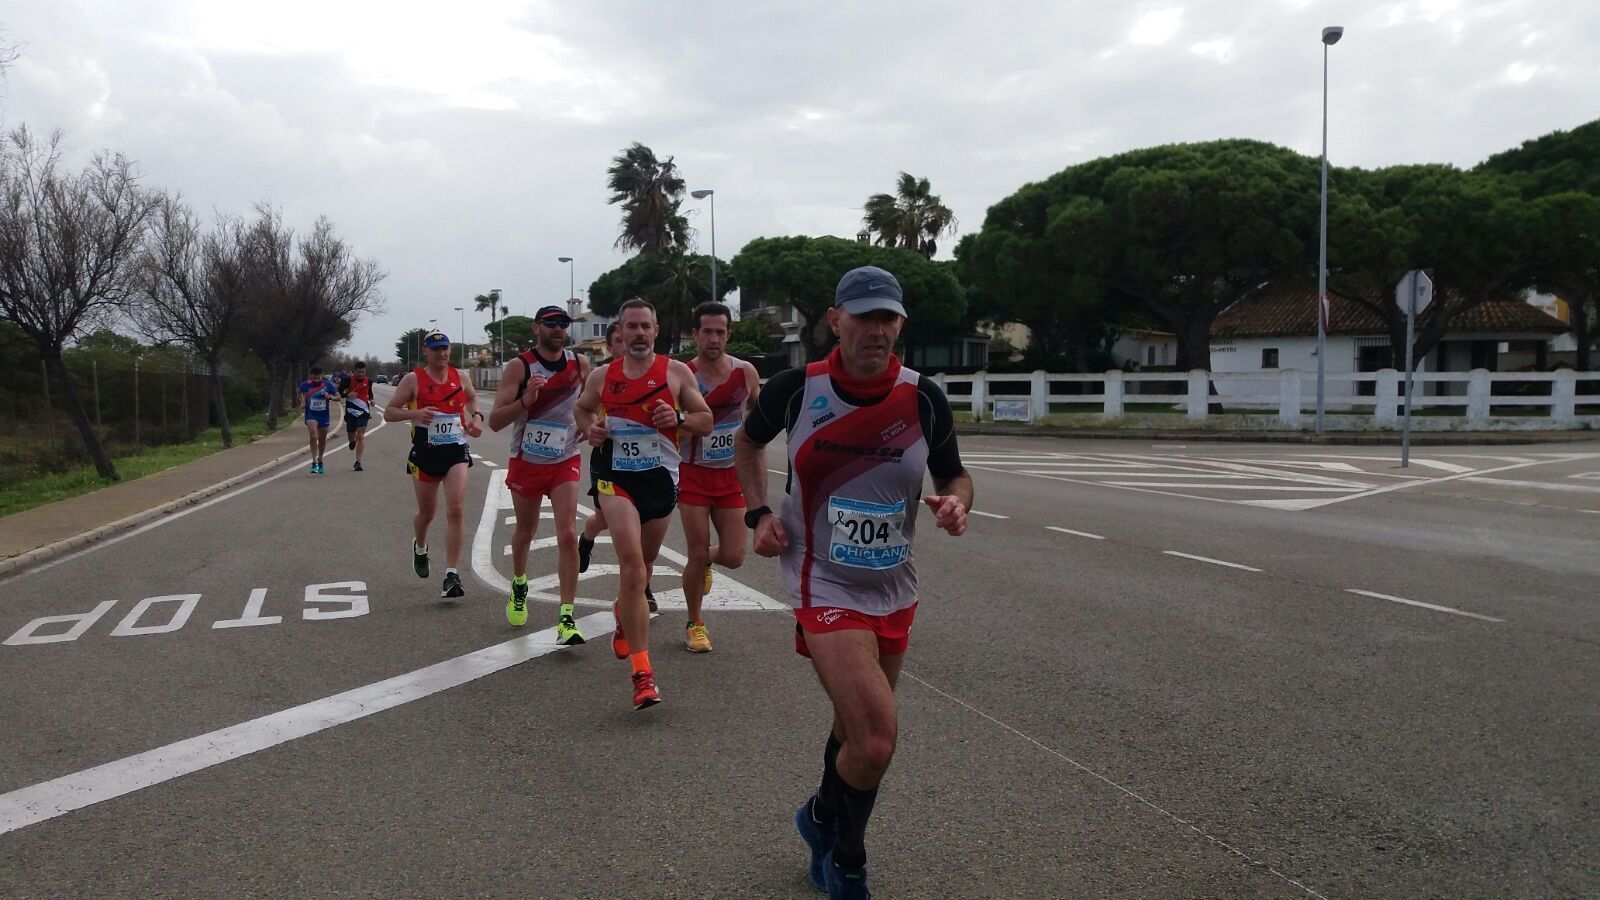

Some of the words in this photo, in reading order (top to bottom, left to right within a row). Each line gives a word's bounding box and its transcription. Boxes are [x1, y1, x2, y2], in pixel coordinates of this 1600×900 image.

[434, 422, 453, 434] 107
[534, 430, 551, 445] 37
[711, 433, 733, 449] 206
[621, 442, 640, 457] 85
[814, 440, 905, 458] Vanessa
[614, 457, 661, 469] CHICLANA
[844, 519, 890, 545] 204
[832, 544, 907, 562] CHICLANA
[2, 581, 370, 645] STOP
